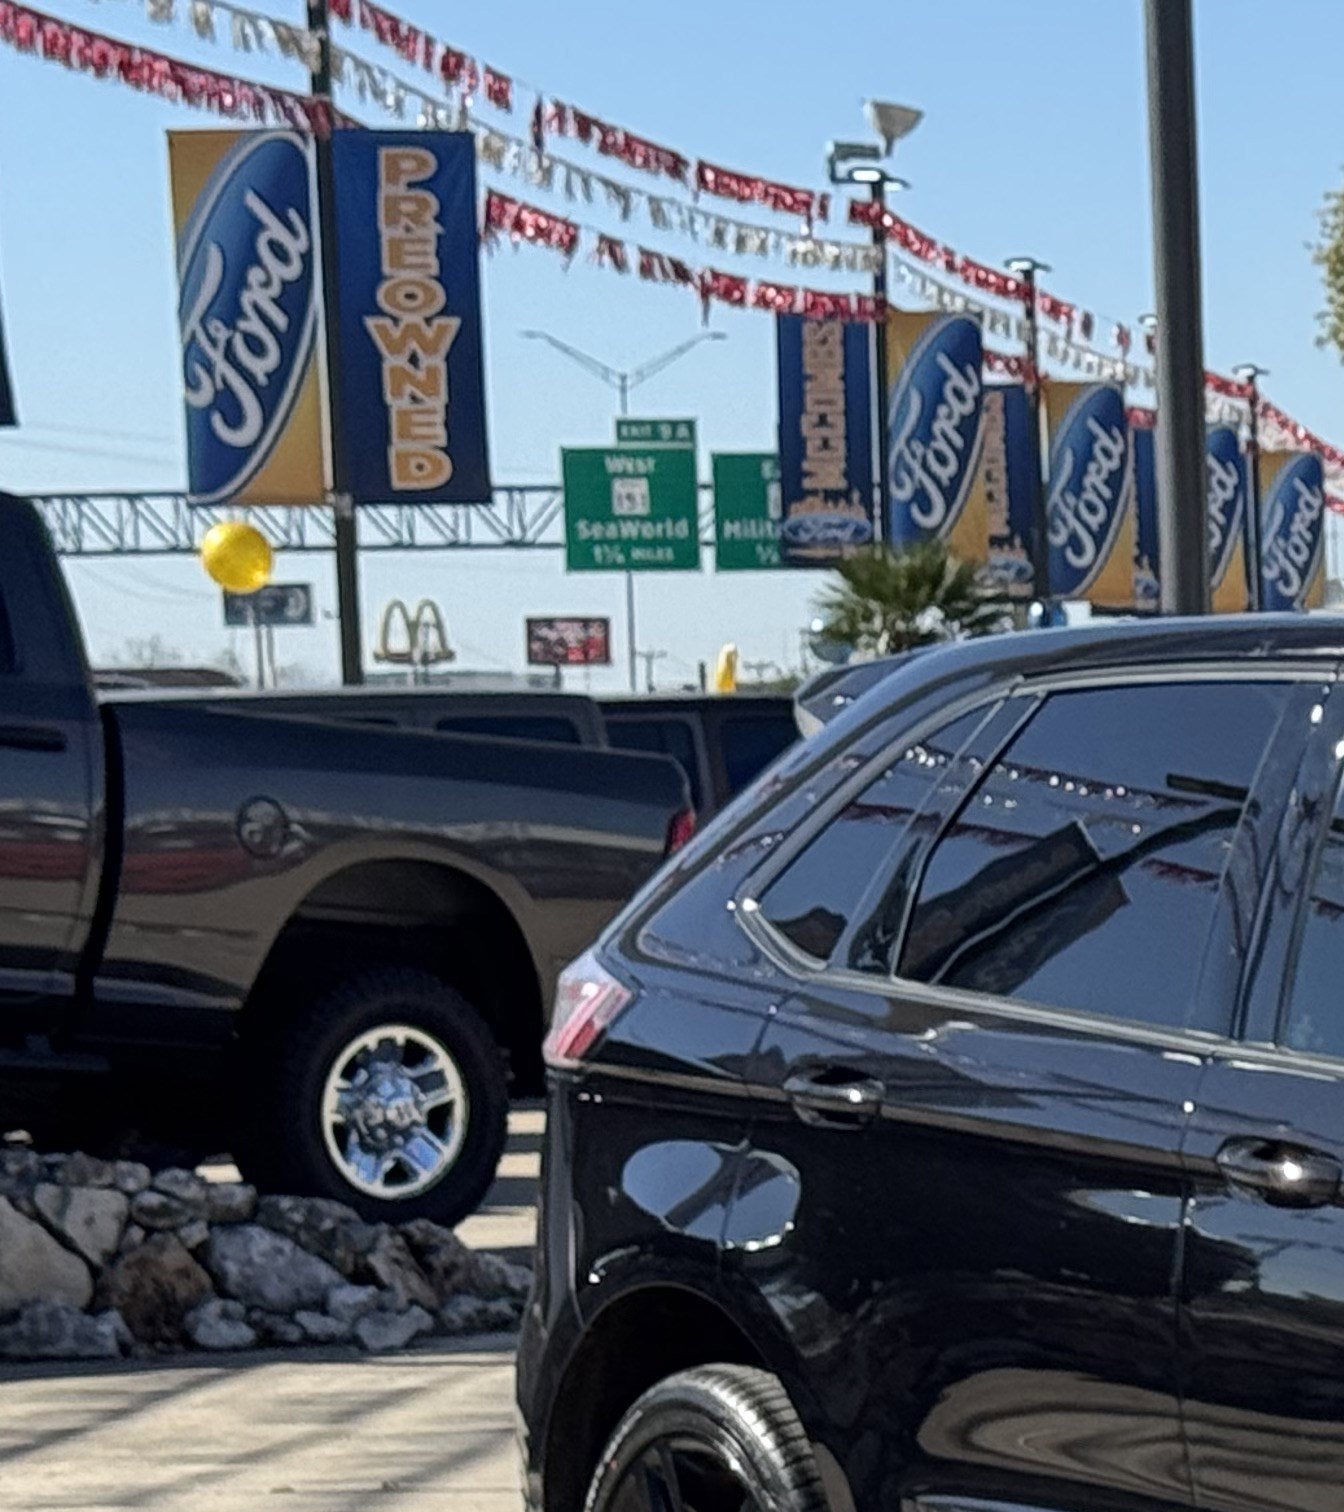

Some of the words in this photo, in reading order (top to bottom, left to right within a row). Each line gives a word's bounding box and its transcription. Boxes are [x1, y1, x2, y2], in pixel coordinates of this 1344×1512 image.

[184, 188, 309, 448] Ford
[363, 145, 461, 490] PREOWNED
[889, 352, 982, 529] Ford
[1047, 416, 1124, 568] Ford
[575, 517, 690, 541] SeaWorld
[1263, 477, 1323, 597] Ford
